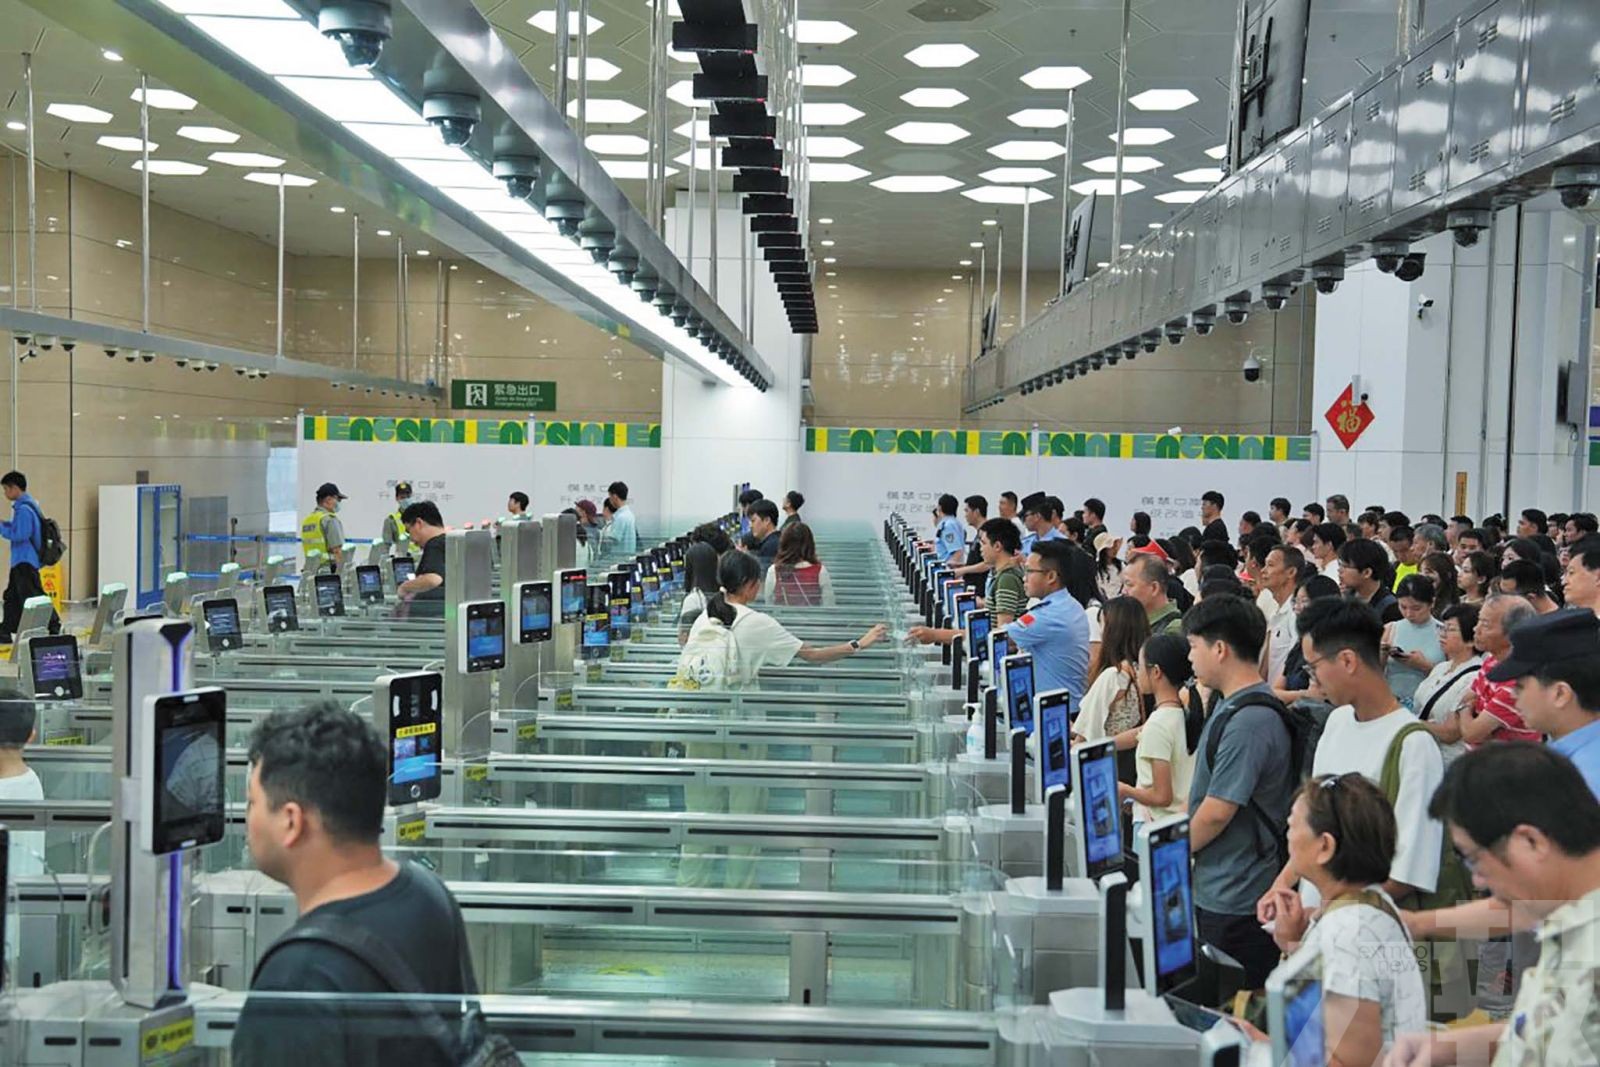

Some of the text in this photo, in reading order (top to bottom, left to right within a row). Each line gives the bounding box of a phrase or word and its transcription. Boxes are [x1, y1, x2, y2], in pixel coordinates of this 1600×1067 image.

[494, 384, 540, 396] 緊急出口
[1337, 400, 1361, 433] 福
